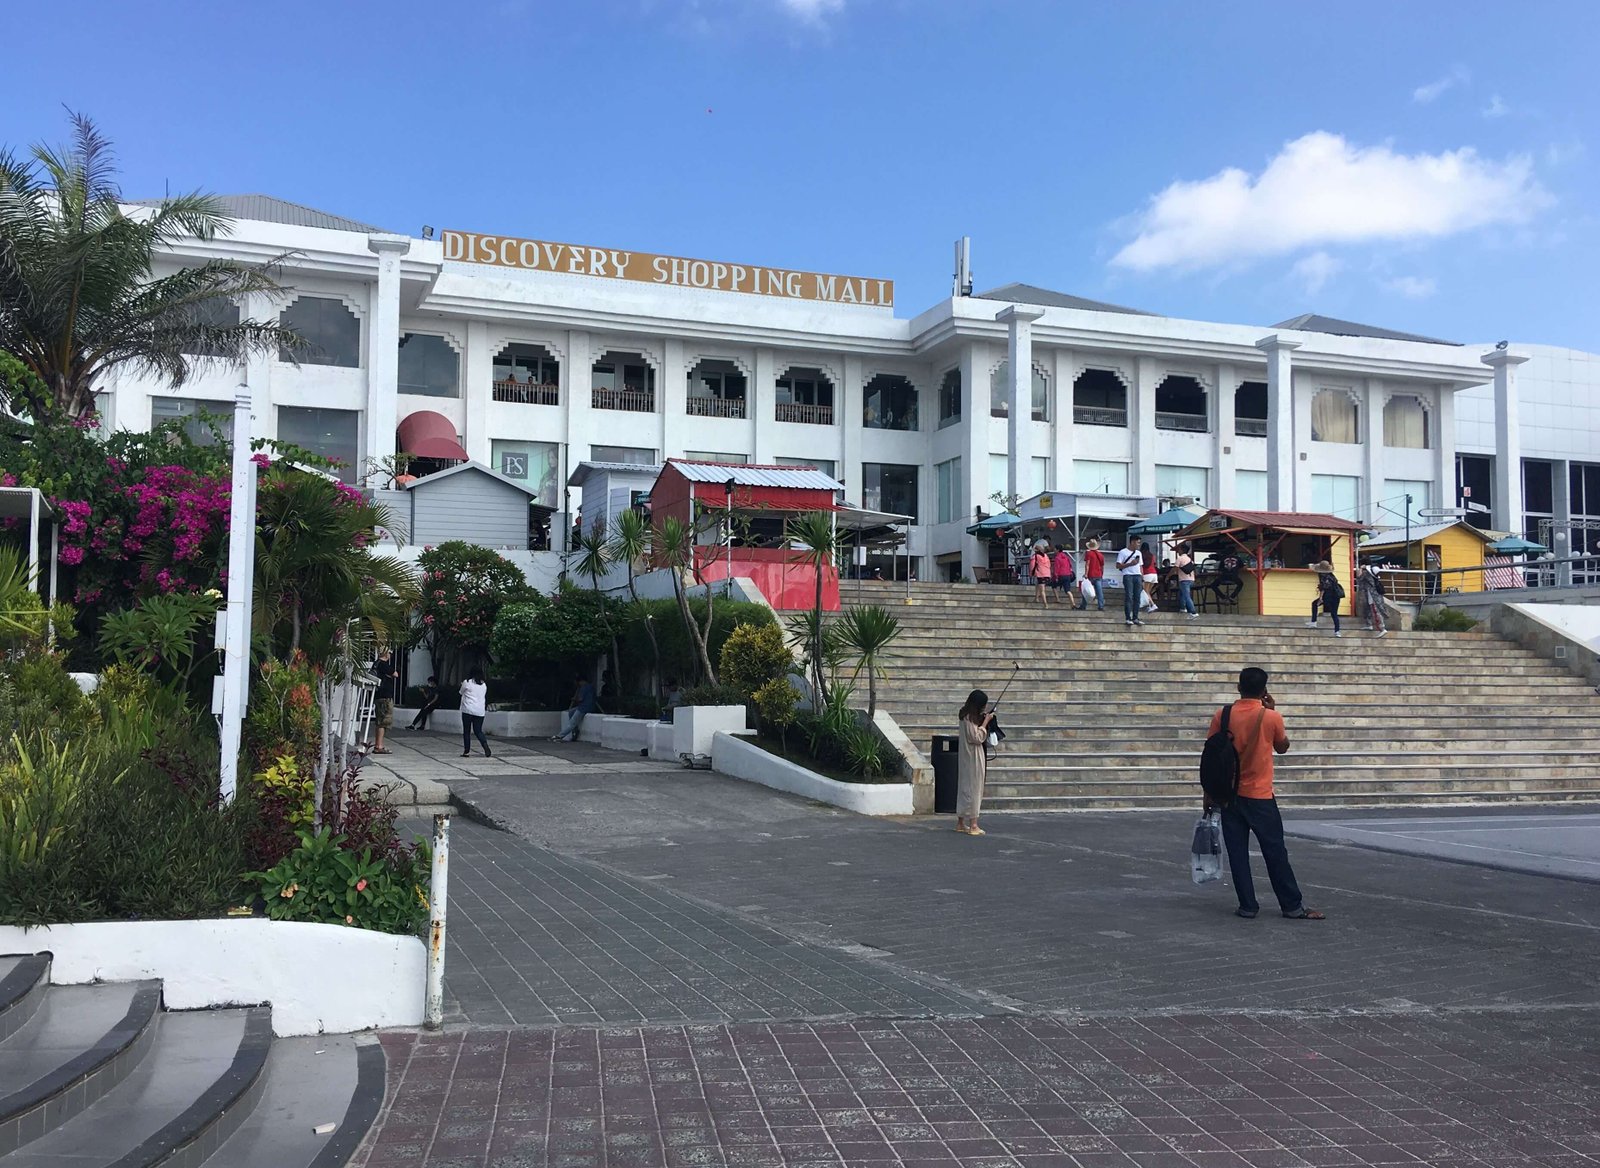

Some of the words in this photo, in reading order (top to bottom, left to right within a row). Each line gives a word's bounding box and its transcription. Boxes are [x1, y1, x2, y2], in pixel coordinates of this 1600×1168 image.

[443, 231, 632, 278] DISCOVERY
[652, 256, 803, 298] SHOPPING
[814, 274, 893, 307] MALL
